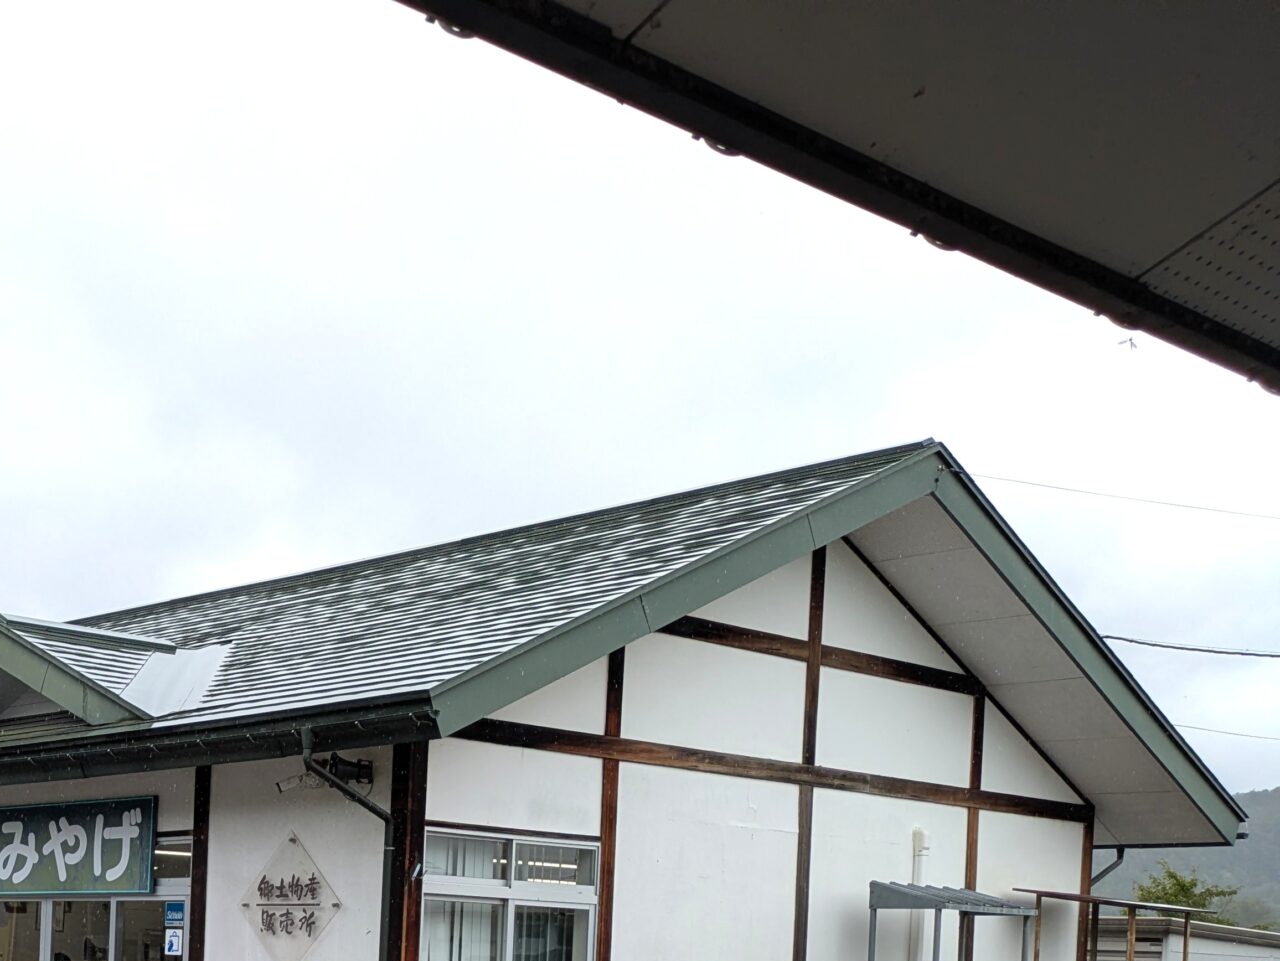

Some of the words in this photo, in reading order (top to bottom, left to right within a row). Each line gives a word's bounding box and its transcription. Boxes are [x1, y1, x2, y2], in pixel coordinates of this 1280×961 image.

[257, 872, 321, 902] 郷土物産
[260, 908, 316, 938] 販売所
